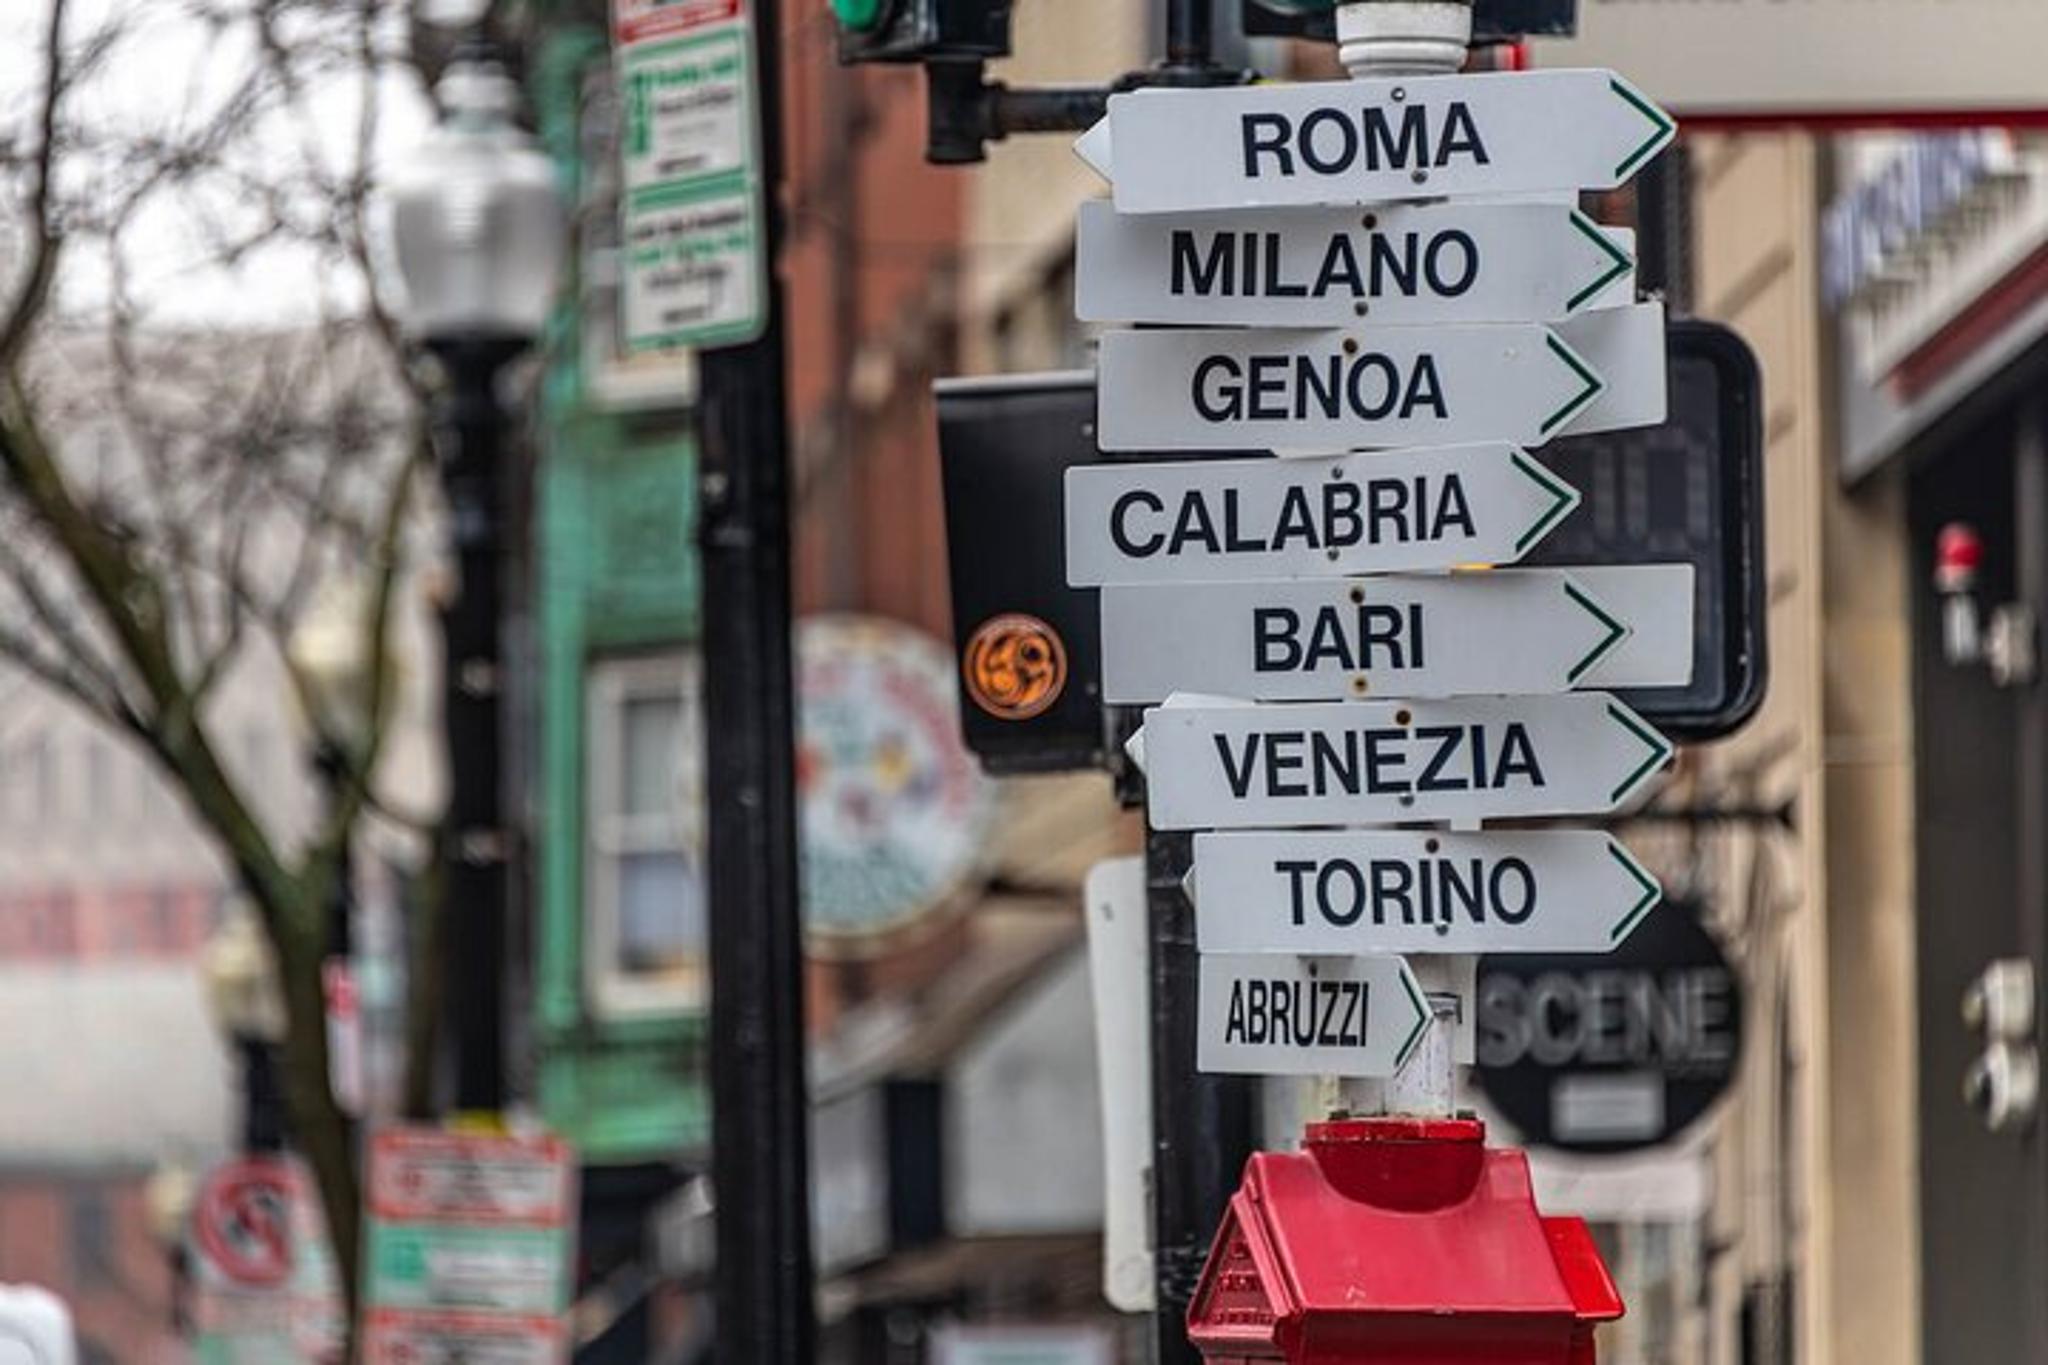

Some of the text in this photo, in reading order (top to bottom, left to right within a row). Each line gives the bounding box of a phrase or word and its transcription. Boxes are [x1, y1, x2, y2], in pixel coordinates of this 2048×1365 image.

[1242, 102, 1489, 177] ROMA
[1170, 229, 1478, 298] MILANO
[1192, 353, 1448, 423] GENOA
[1110, 474, 1476, 558] CALABRIA
[1254, 603, 1423, 672] BARI
[1214, 722, 1545, 798] VENEZIA
[1275, 856, 1536, 926] TORINO
[1225, 979, 1369, 1047] ABRUZZI
[1478, 966, 1734, 1068] SCENE
